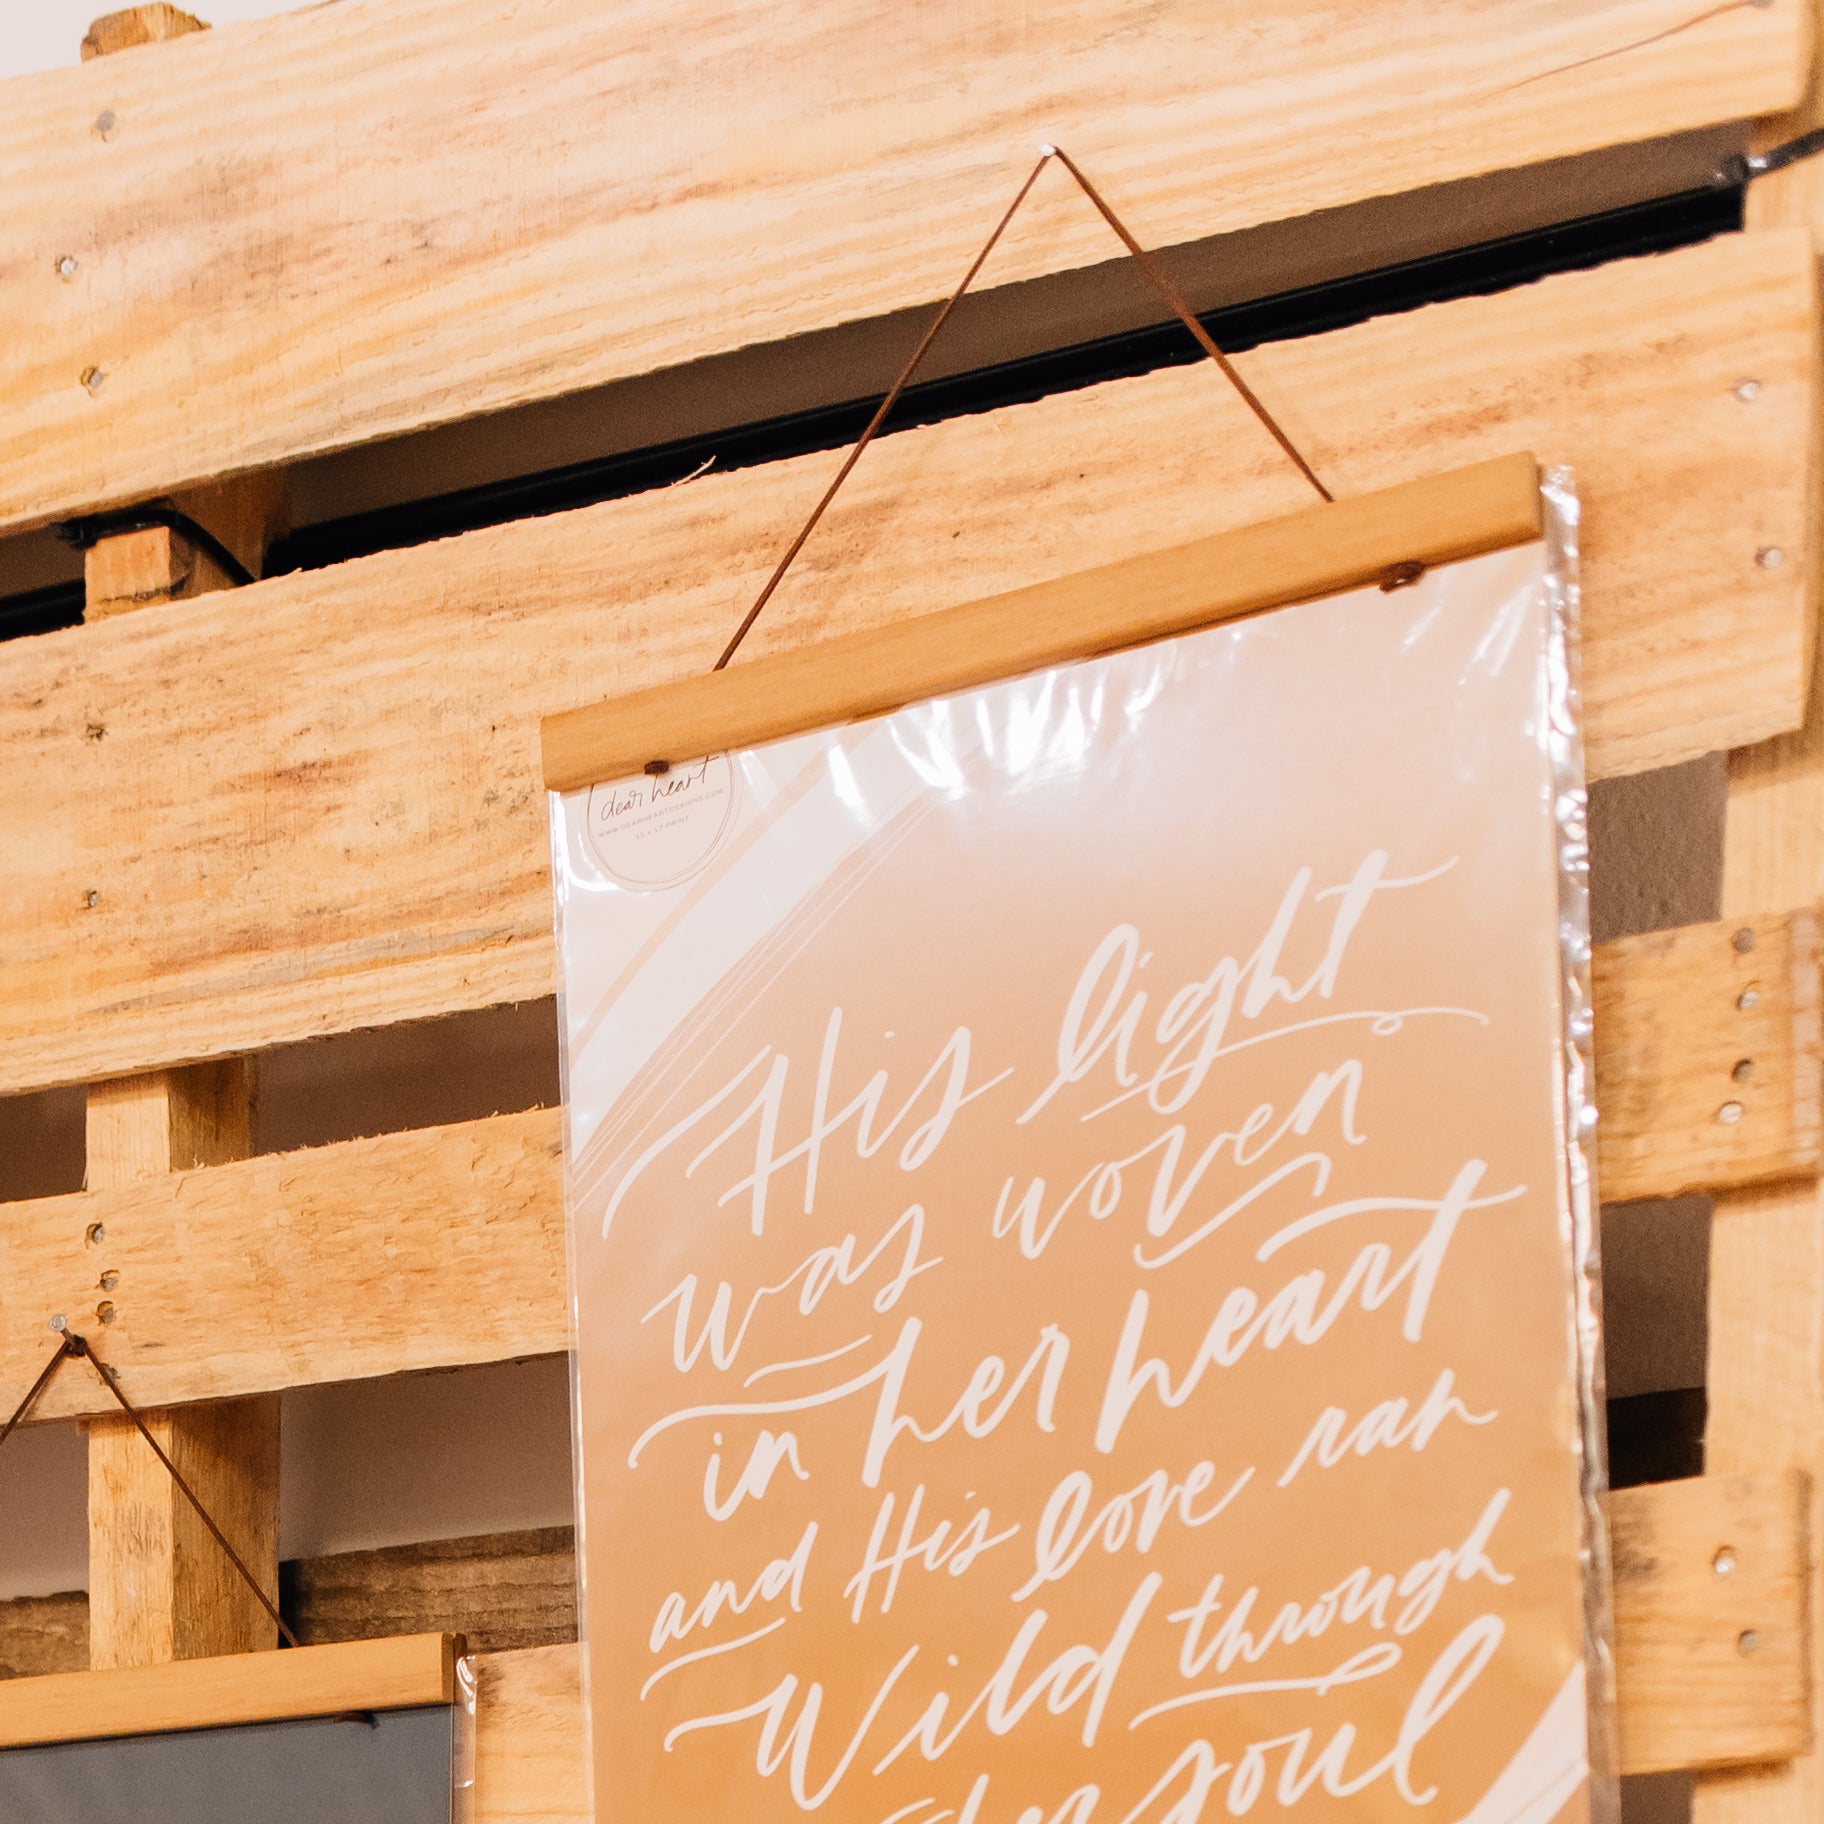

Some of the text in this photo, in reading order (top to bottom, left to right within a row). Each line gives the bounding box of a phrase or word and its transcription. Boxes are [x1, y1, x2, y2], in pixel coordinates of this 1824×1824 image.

[603, 848, 1466, 1239] His light
[640, 1056, 1368, 1374] was woven
[702, 1430, 811, 1522] in
[1093, 1158, 1529, 1454] heart
[648, 1368, 1499, 1654] and His love ran
[664, 1489, 1516, 1812] Wild through
